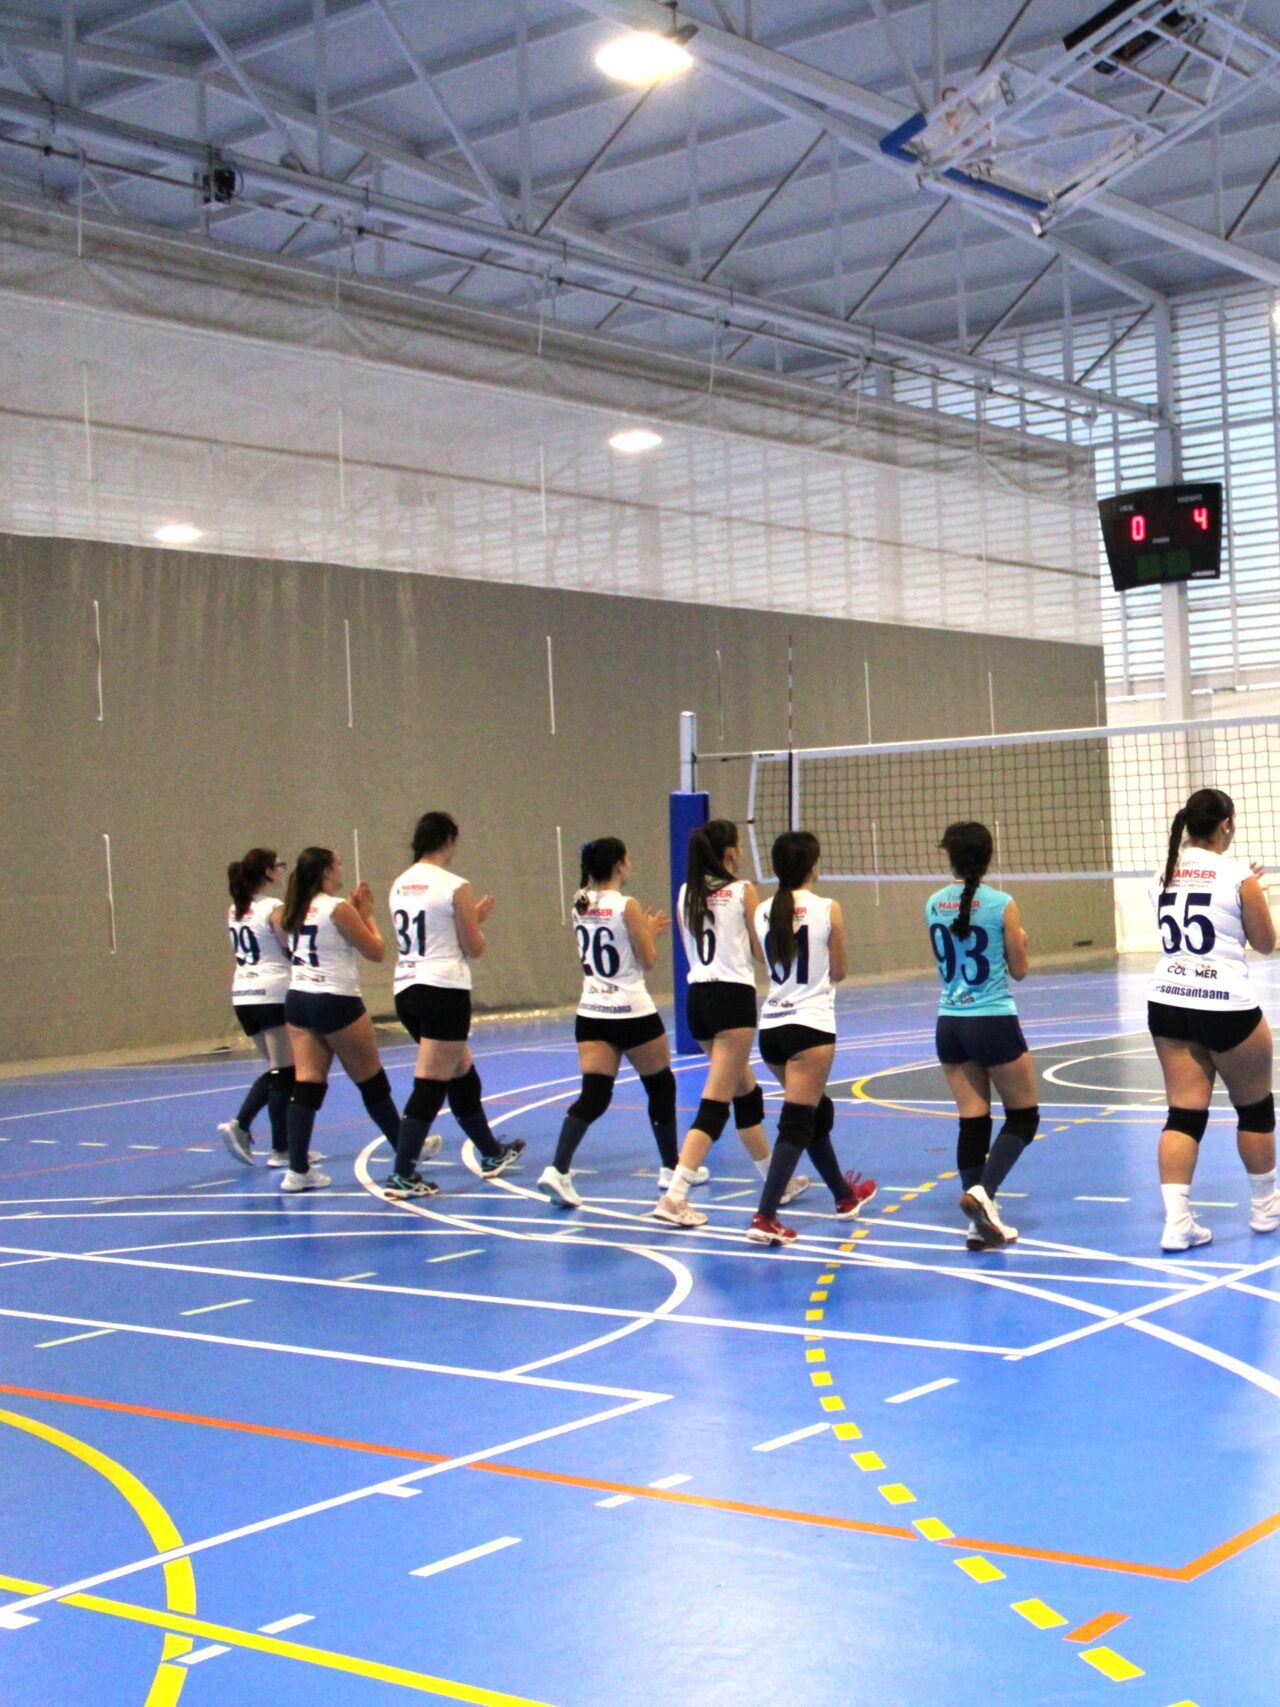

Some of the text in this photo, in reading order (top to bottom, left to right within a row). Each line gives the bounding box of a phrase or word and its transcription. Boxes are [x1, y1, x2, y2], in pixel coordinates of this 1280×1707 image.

[1131, 515, 1146, 542] 0
[1193, 507, 1208, 531] 4
[1168, 869, 1217, 880] AINSER
[938, 900, 980, 909] MAINER
[394, 909, 426, 957] 31
[1158, 892, 1217, 955] 55
[576, 925, 620, 978] 26
[930, 923, 990, 986] 93
